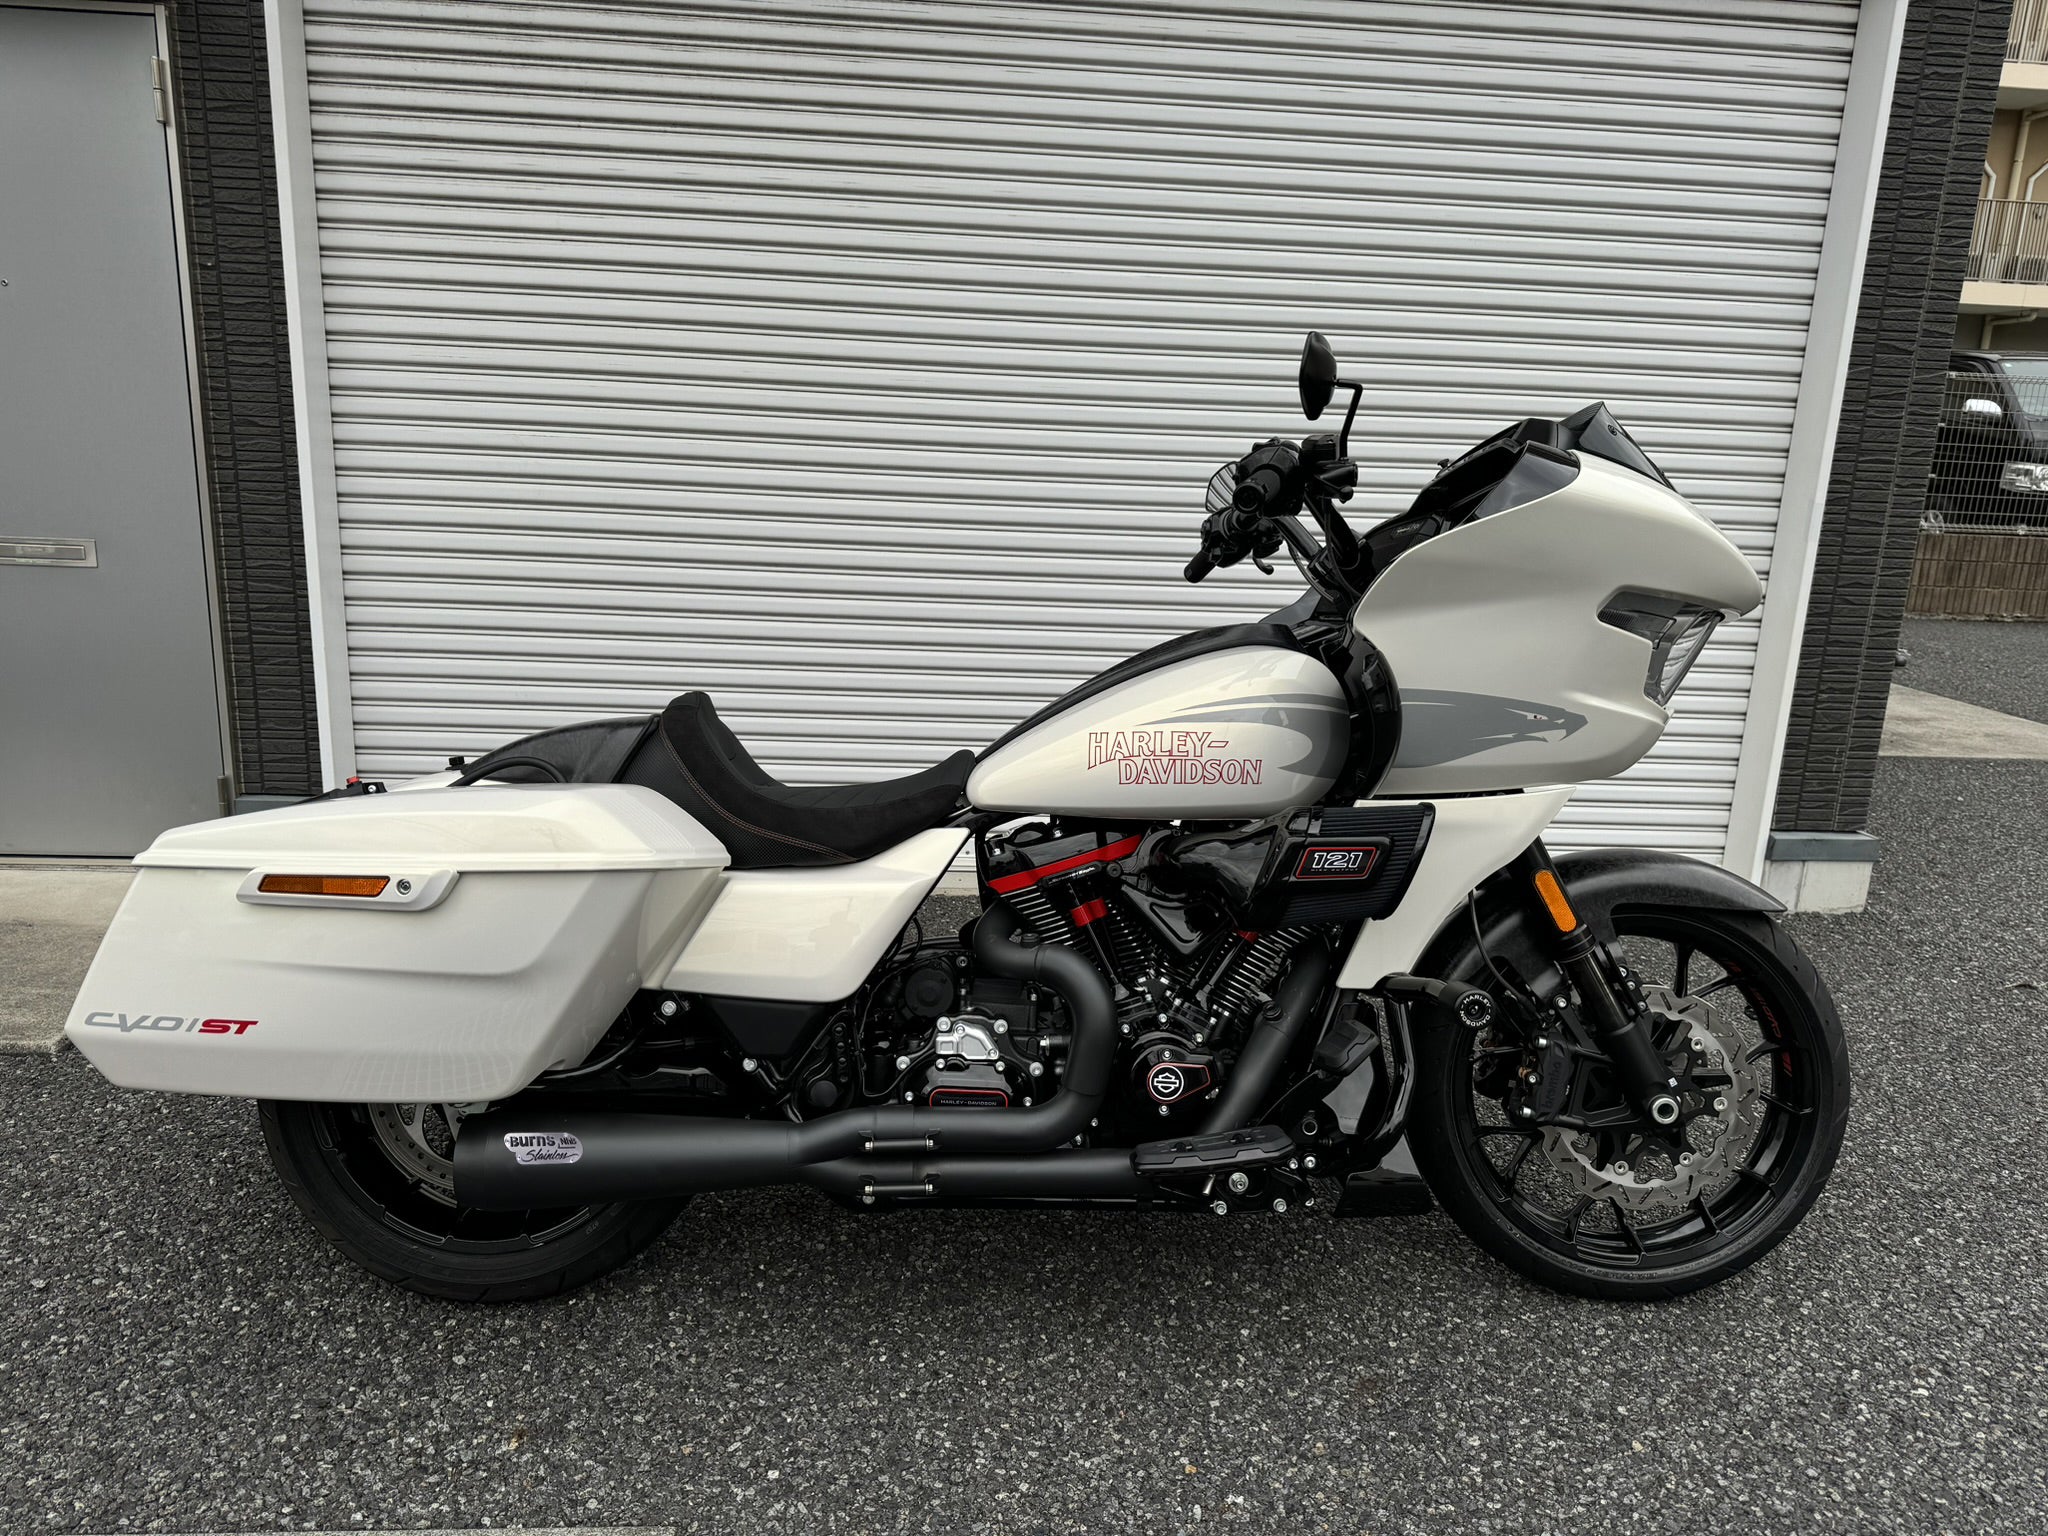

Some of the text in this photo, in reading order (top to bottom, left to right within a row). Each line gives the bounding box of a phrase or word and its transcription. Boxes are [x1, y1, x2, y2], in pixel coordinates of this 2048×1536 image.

[1088, 731, 1229, 770] HARLEY-
[1118, 758, 1262, 785] DAVIDSON
[1312, 852, 1363, 868] 121
[510, 1136, 556, 1147] Burns
[521, 1148, 580, 1162] Stainless
